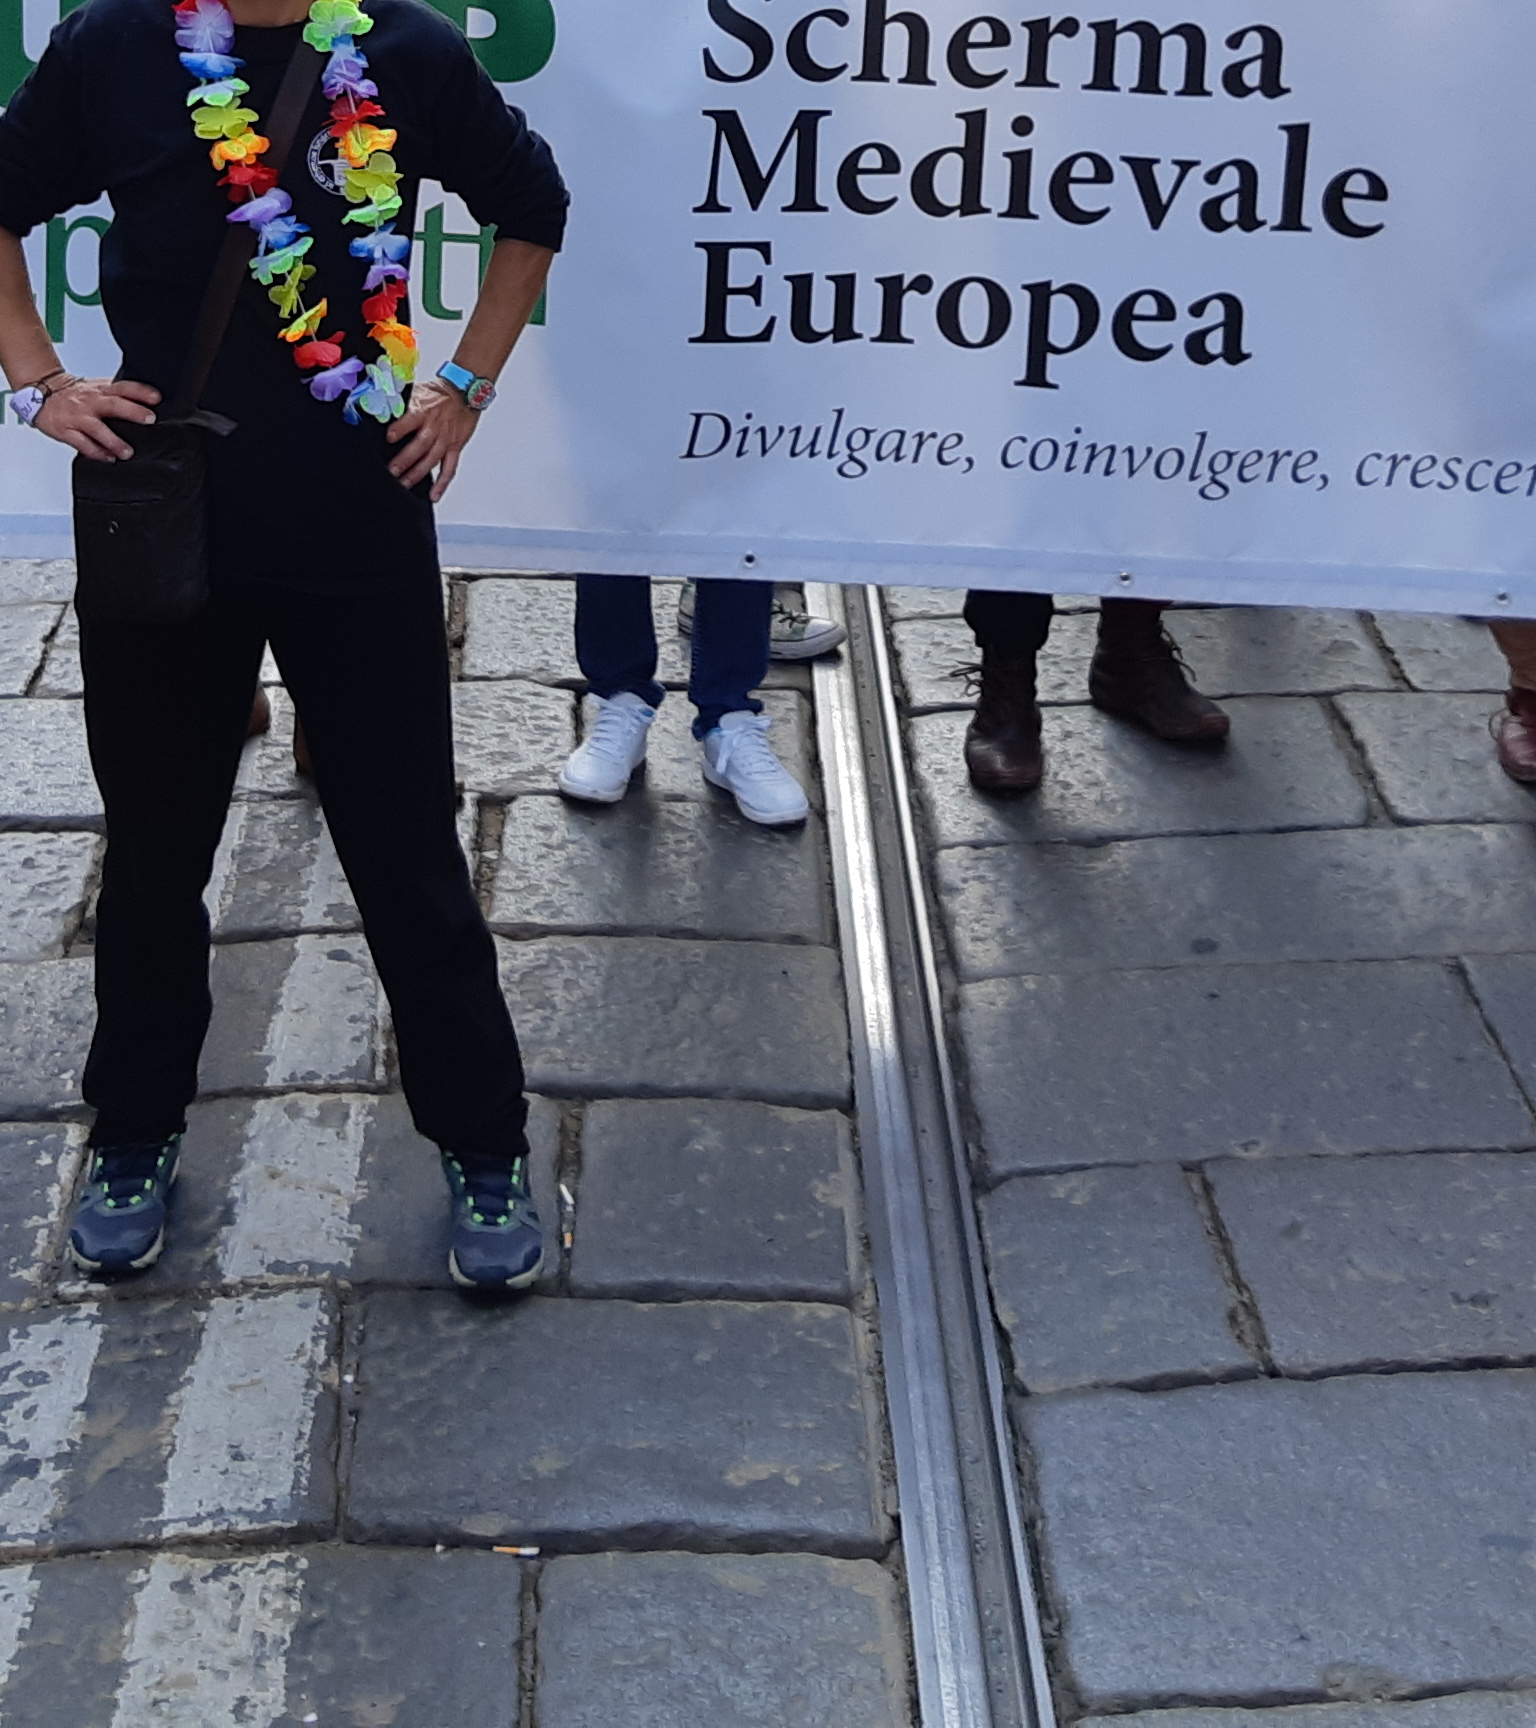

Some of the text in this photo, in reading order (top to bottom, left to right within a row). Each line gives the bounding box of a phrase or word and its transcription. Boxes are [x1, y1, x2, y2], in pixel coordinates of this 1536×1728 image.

[691, 107, 1390, 239] Medievale
[688, 240, 1253, 391] Europea
[678, 407, 975, 479] Divulgare,
[999, 421, 1329, 501] coinvolgere,
